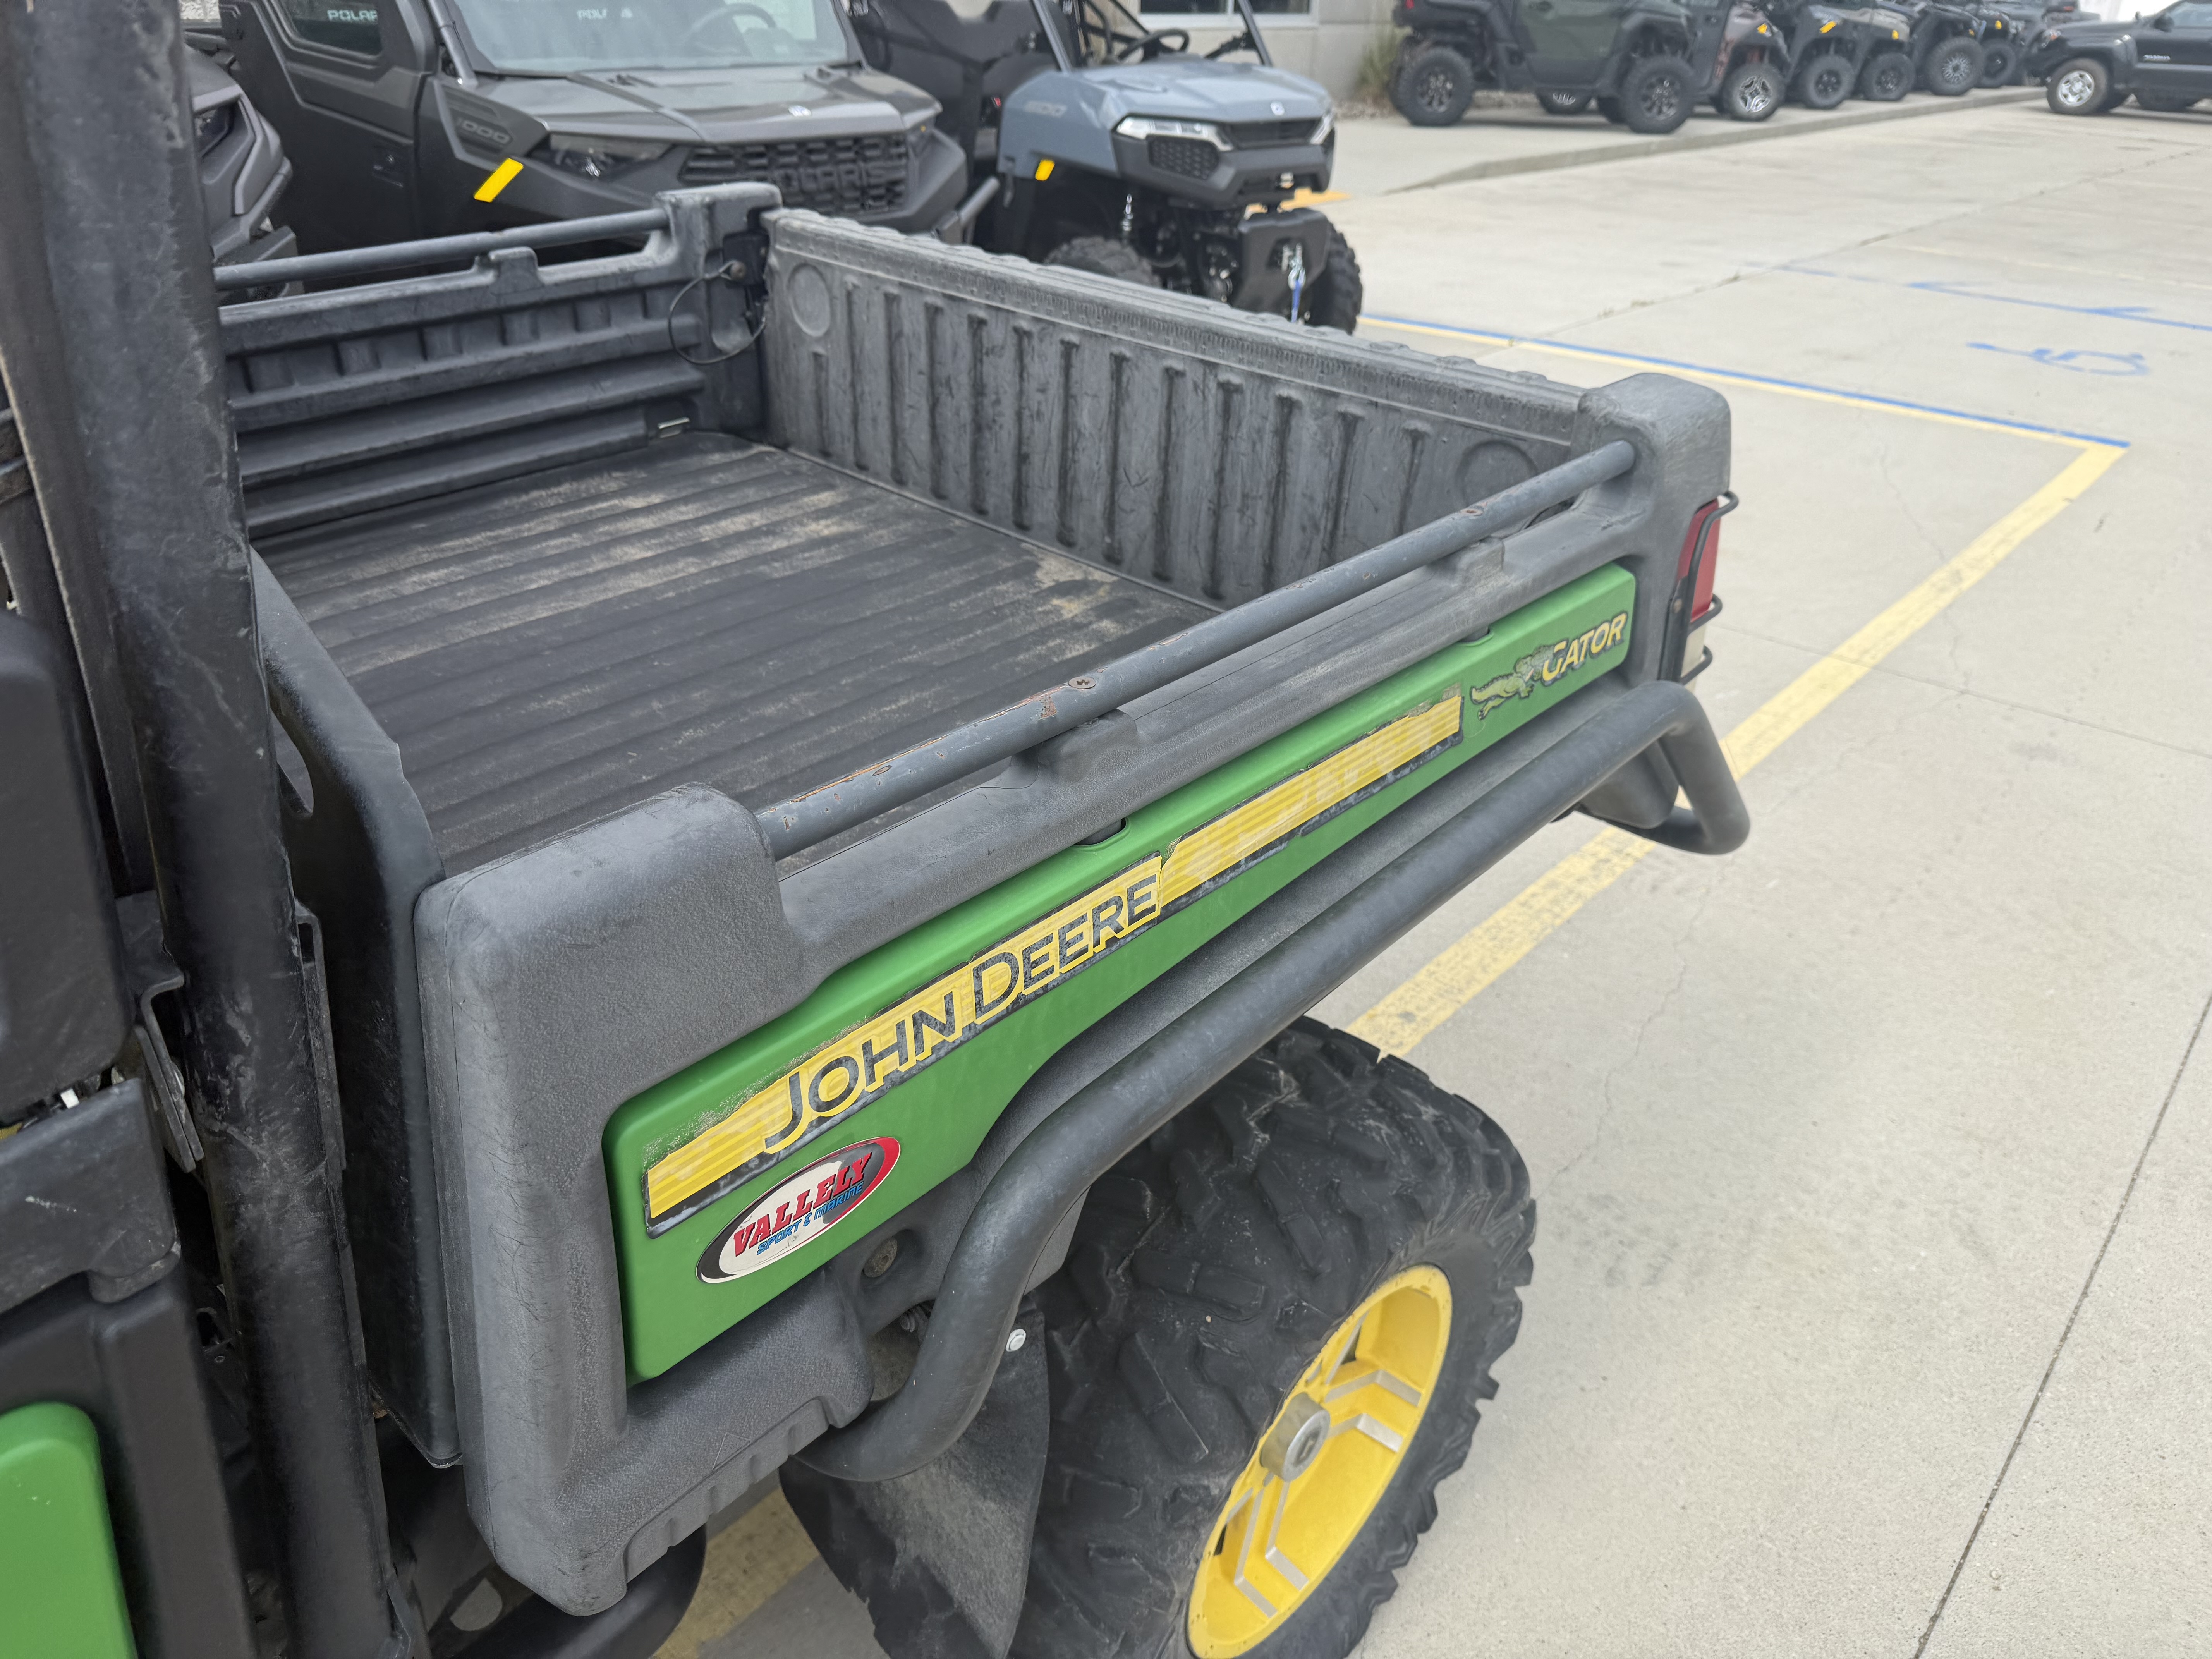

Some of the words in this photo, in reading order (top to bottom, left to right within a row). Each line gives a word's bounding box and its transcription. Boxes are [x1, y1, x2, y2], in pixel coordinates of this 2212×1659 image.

[775, 160, 906, 194] OLARIS
[1541, 612, 1627, 684] GATOR
[764, 991, 957, 1150] JOHN
[972, 873, 1157, 1021] DEERE
[733, 1152, 872, 1257] VALLELY
[756, 1219, 802, 1255] SPORT
[803, 1212, 812, 1227] &
[814, 1181, 864, 1221] MARINE
